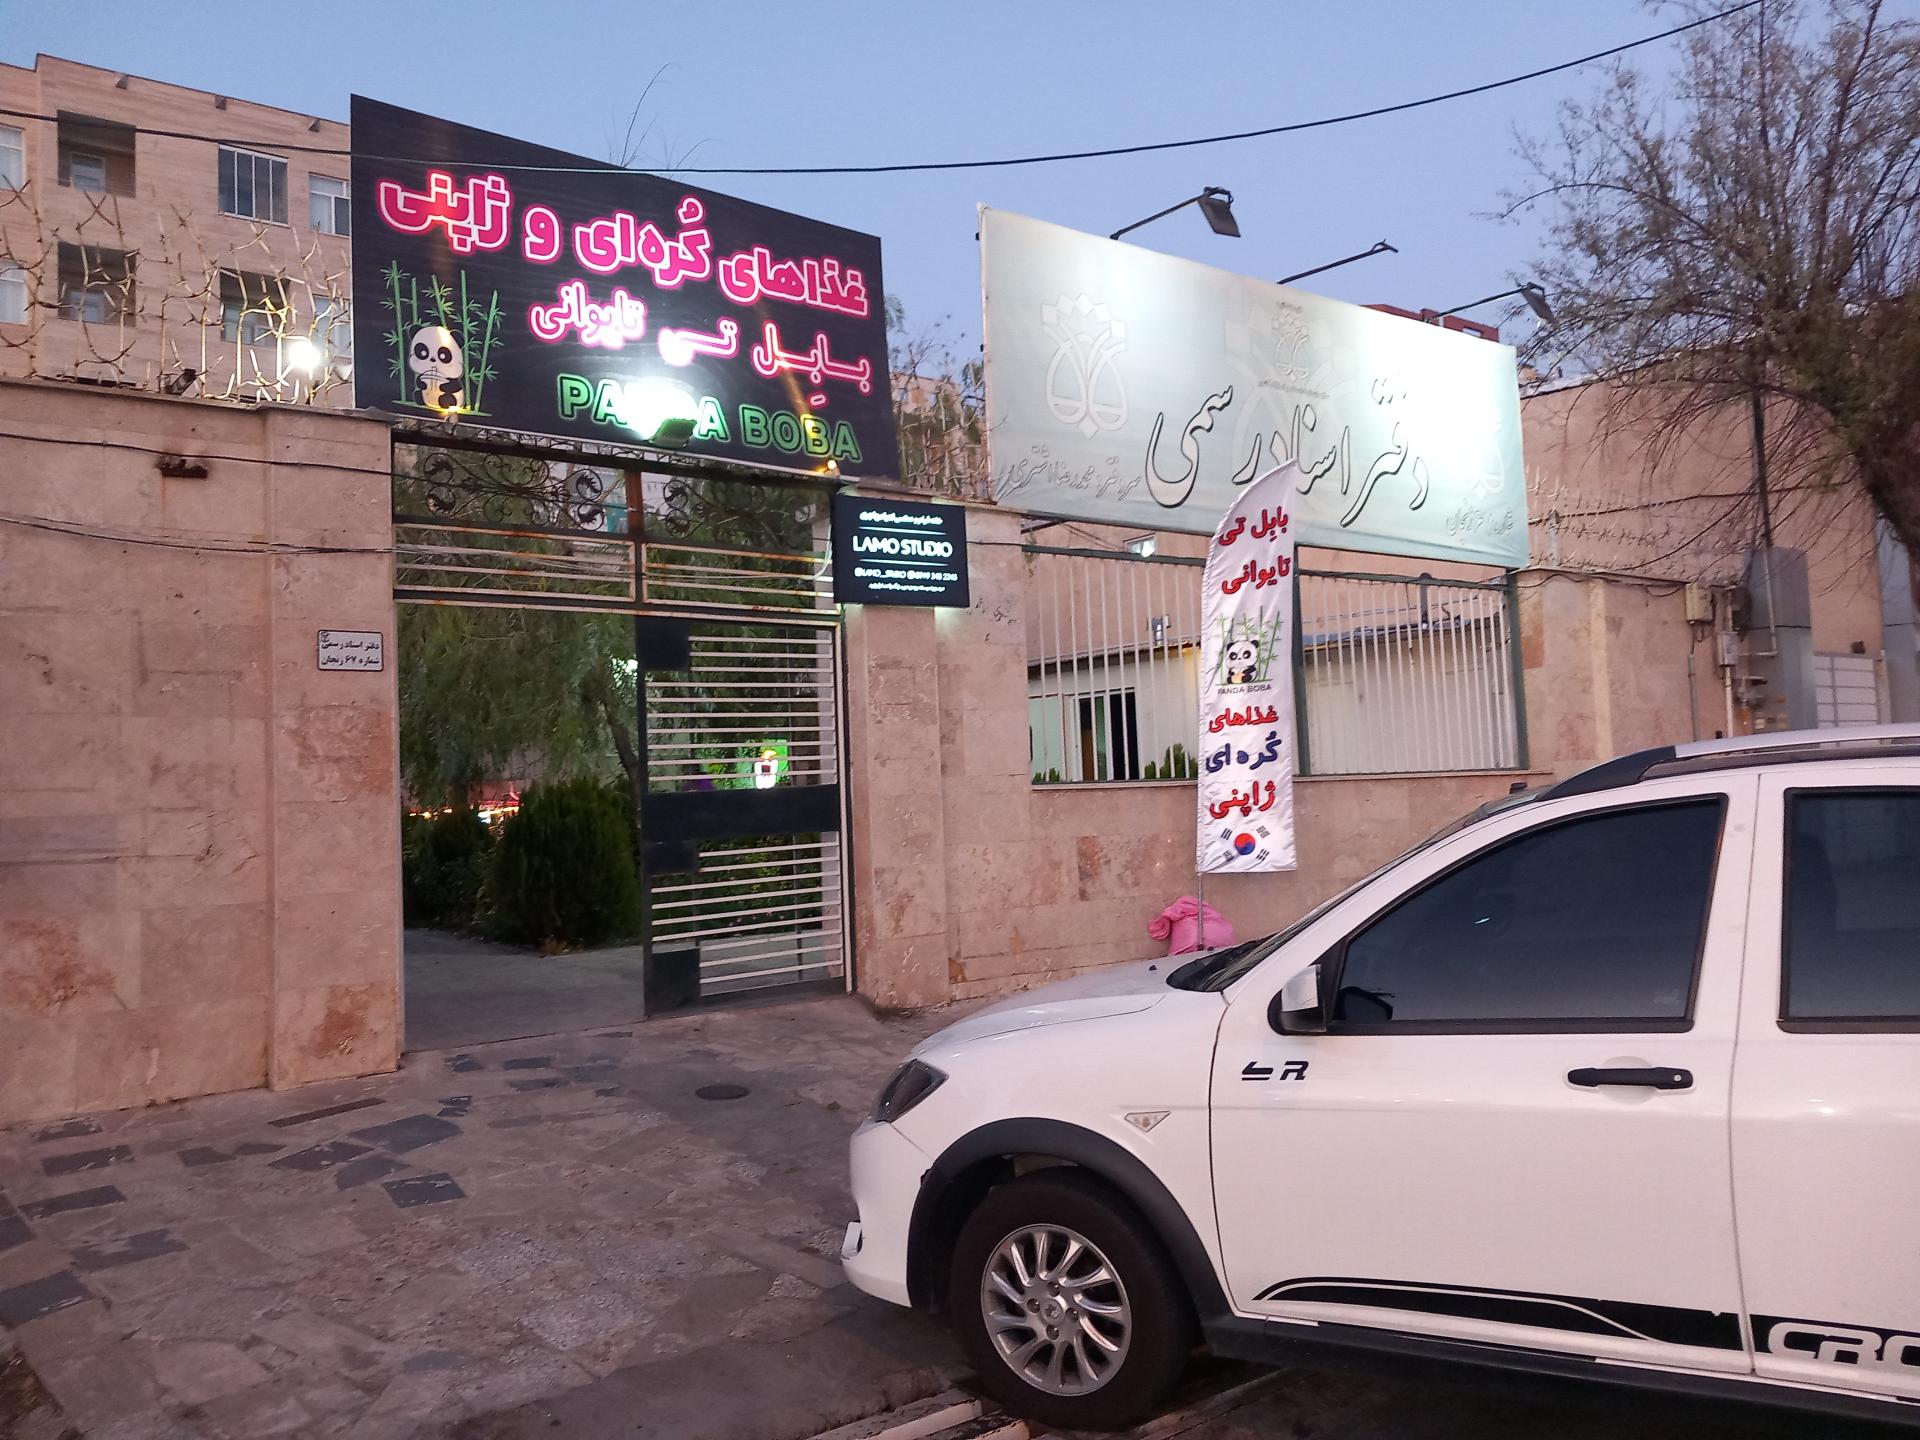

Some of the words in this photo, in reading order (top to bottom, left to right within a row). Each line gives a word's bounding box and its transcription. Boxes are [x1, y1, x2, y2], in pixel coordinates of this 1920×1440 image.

[377, 170, 511, 254] ژاپنی
[522, 205, 562, 263] و
[718, 245, 870, 318] غذاهای
[528, 280, 648, 350] تایوانی
[557, 371, 730, 443] PAA
[738, 402, 863, 463] BOBA
[1144, 384, 1263, 509] رسمی
[1339, 372, 1430, 529] دفتر
[852, 535, 900, 555] LAMO
[900, 538, 953, 558] STUDIO
[1219, 517, 1246, 546] تی
[1222, 555, 1292, 595] تایوانی
[358, 656, 380, 667] شماره
[364, 641, 380, 652] دفتر
[1217, 686, 1245, 696] PANDA
[1246, 684, 1272, 694] BOBA
[1208, 704, 1280, 733] غذاهای
[1209, 780, 1276, 819] ژاپنی
